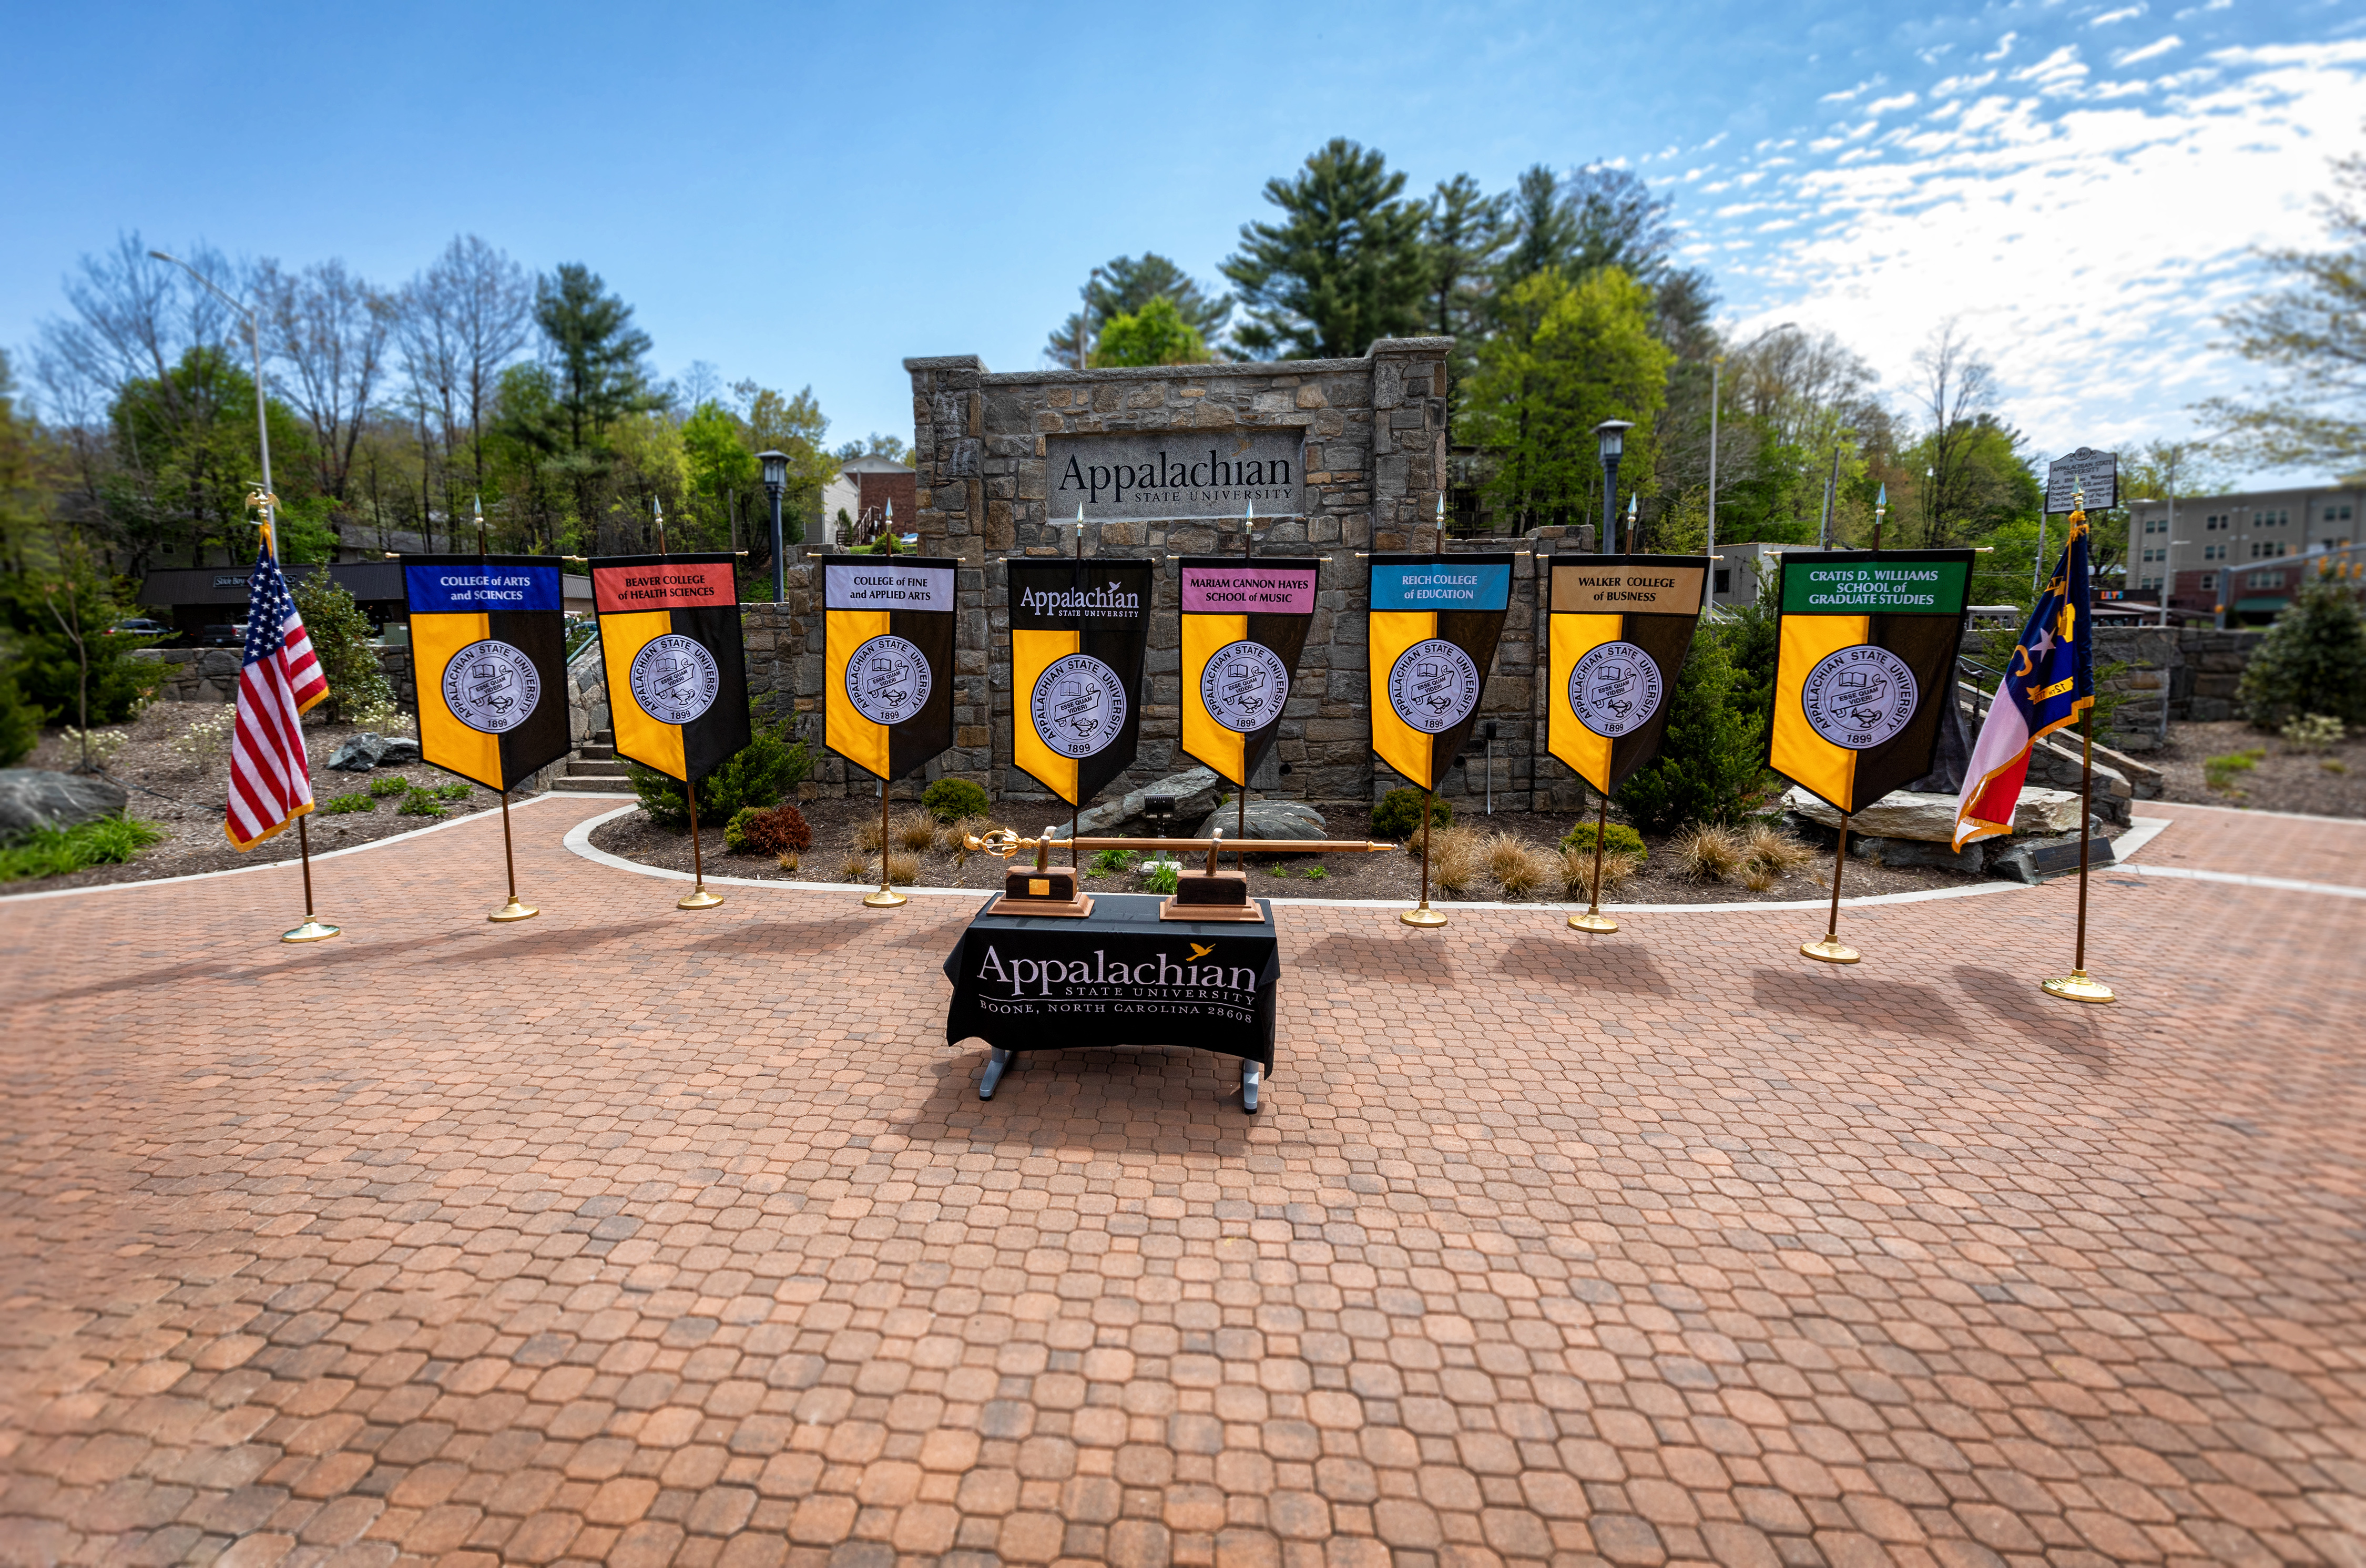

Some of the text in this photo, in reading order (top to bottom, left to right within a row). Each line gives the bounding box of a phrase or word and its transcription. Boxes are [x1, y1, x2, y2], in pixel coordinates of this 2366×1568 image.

[2053, 463, 2093, 472] APPALACHIAN
[2064, 467, 2099, 475] UNIVERSITY
[1058, 450, 1292, 503] Appalachian
[1135, 489, 1292, 502] STATE UNIVERSITY
[440, 576, 530, 586] COLLEGE of ARTS
[626, 575, 705, 587] BEAVER COLLEGE
[1402, 575, 1477, 585] REICH COLLEGE
[1810, 571, 1938, 581] CRATIS D. WILLIAMS
[232, 577, 244, 586] Boy
[854, 576, 893, 586] COLLEGE
[907, 578, 927, 587] FINE
[1190, 578, 1308, 589] MARIAM CANNON HAYES
[1579, 577, 1675, 587] WALKER COLLEGE
[1837, 582, 1907, 593] SCHOOL of
[451, 590, 523, 600] and SCIENCES
[618, 587, 714, 600] of HEALTH SCIENCES
[850, 590, 930, 600] and APPLIED ARTS
[1206, 593, 1292, 603] SCHOOL of MUSIC
[1404, 589, 1473, 599] of EDUCATION
[1594, 592, 1656, 602] of BUSINESS
[1021, 586, 1139, 616] Appalachian
[1809, 594, 1934, 605] GRADUATE STUDIES
[636, 639, 715, 711] APPALACHIAN STATE UNIVERSITY
[674, 669, 688, 679] QUAM
[851, 640, 927, 709] APPALACHIAN STATE UNIVERSITY
[449, 645, 535, 718] APPALACHIAN STATE UNIVERSITY
[476, 677, 505, 692] ESSE QUAM
[668, 677, 684, 686] VIDERI
[879, 678, 896, 687] VIDERI
[1206, 646, 1284, 716] APPALACHIAN STATE UNIVERSITY
[1242, 677, 1257, 686] QUAM
[1394, 644, 1474, 716] APPALACHIAN STATE UNIVERSITY
[1432, 676, 1446, 685] QUAM
[1575, 647, 1656, 721] APPALACHIAN STATE UNIVERSITY
[484, 684, 503, 694] VIDERI
[1235, 684, 1253, 694] VIDERI
[1424, 684, 1442, 693] VIDERI
[1598, 680, 1629, 694] ESSE QUAM
[1606, 687, 1625, 696] VIDERI
[1810, 650, 1911, 731] APPALACHIAN STATE UNIVERSITY
[1839, 687, 1879, 701] ESSE QUAM
[1036, 660, 1122, 739] APPALACHIAN STATE UNIVERSITY
[1060, 696, 1092, 710] ESSE QUAM
[1849, 695, 1872, 705] VIDERI
[1068, 705, 1087, 714] VIDERI
[671, 711, 691, 719] 1899
[487, 719, 507, 728] 1899
[1236, 719, 1256, 727] 1899
[1424, 719, 1443, 728] 1899
[1847, 734, 1872, 743] 1899
[1068, 744, 1090, 752] 1899
[977, 945, 1256, 996] Appalachian
[1066, 986, 1255, 1005] STATE UNIVERSITY
[980, 1000, 1252, 1023] BOONE, NORTH CAROLINA 28608
